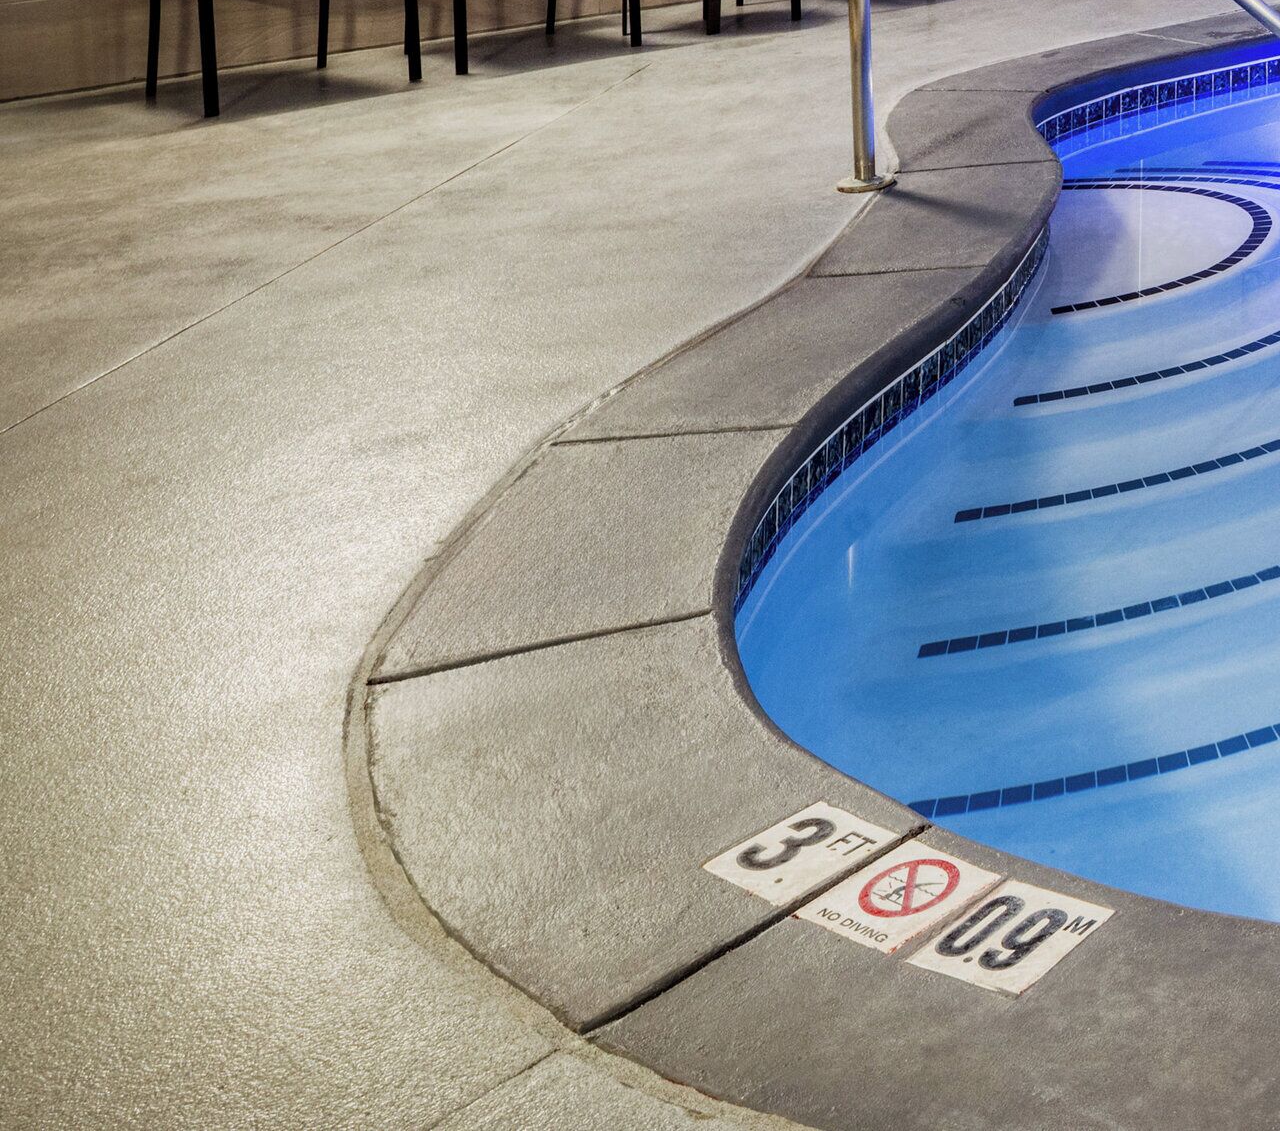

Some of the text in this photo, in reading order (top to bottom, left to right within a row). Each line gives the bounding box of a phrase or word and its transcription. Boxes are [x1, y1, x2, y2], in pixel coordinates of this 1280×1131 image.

[817, 908, 889, 943] NO DIVING
[934, 895, 1098, 971] 0.9 M
